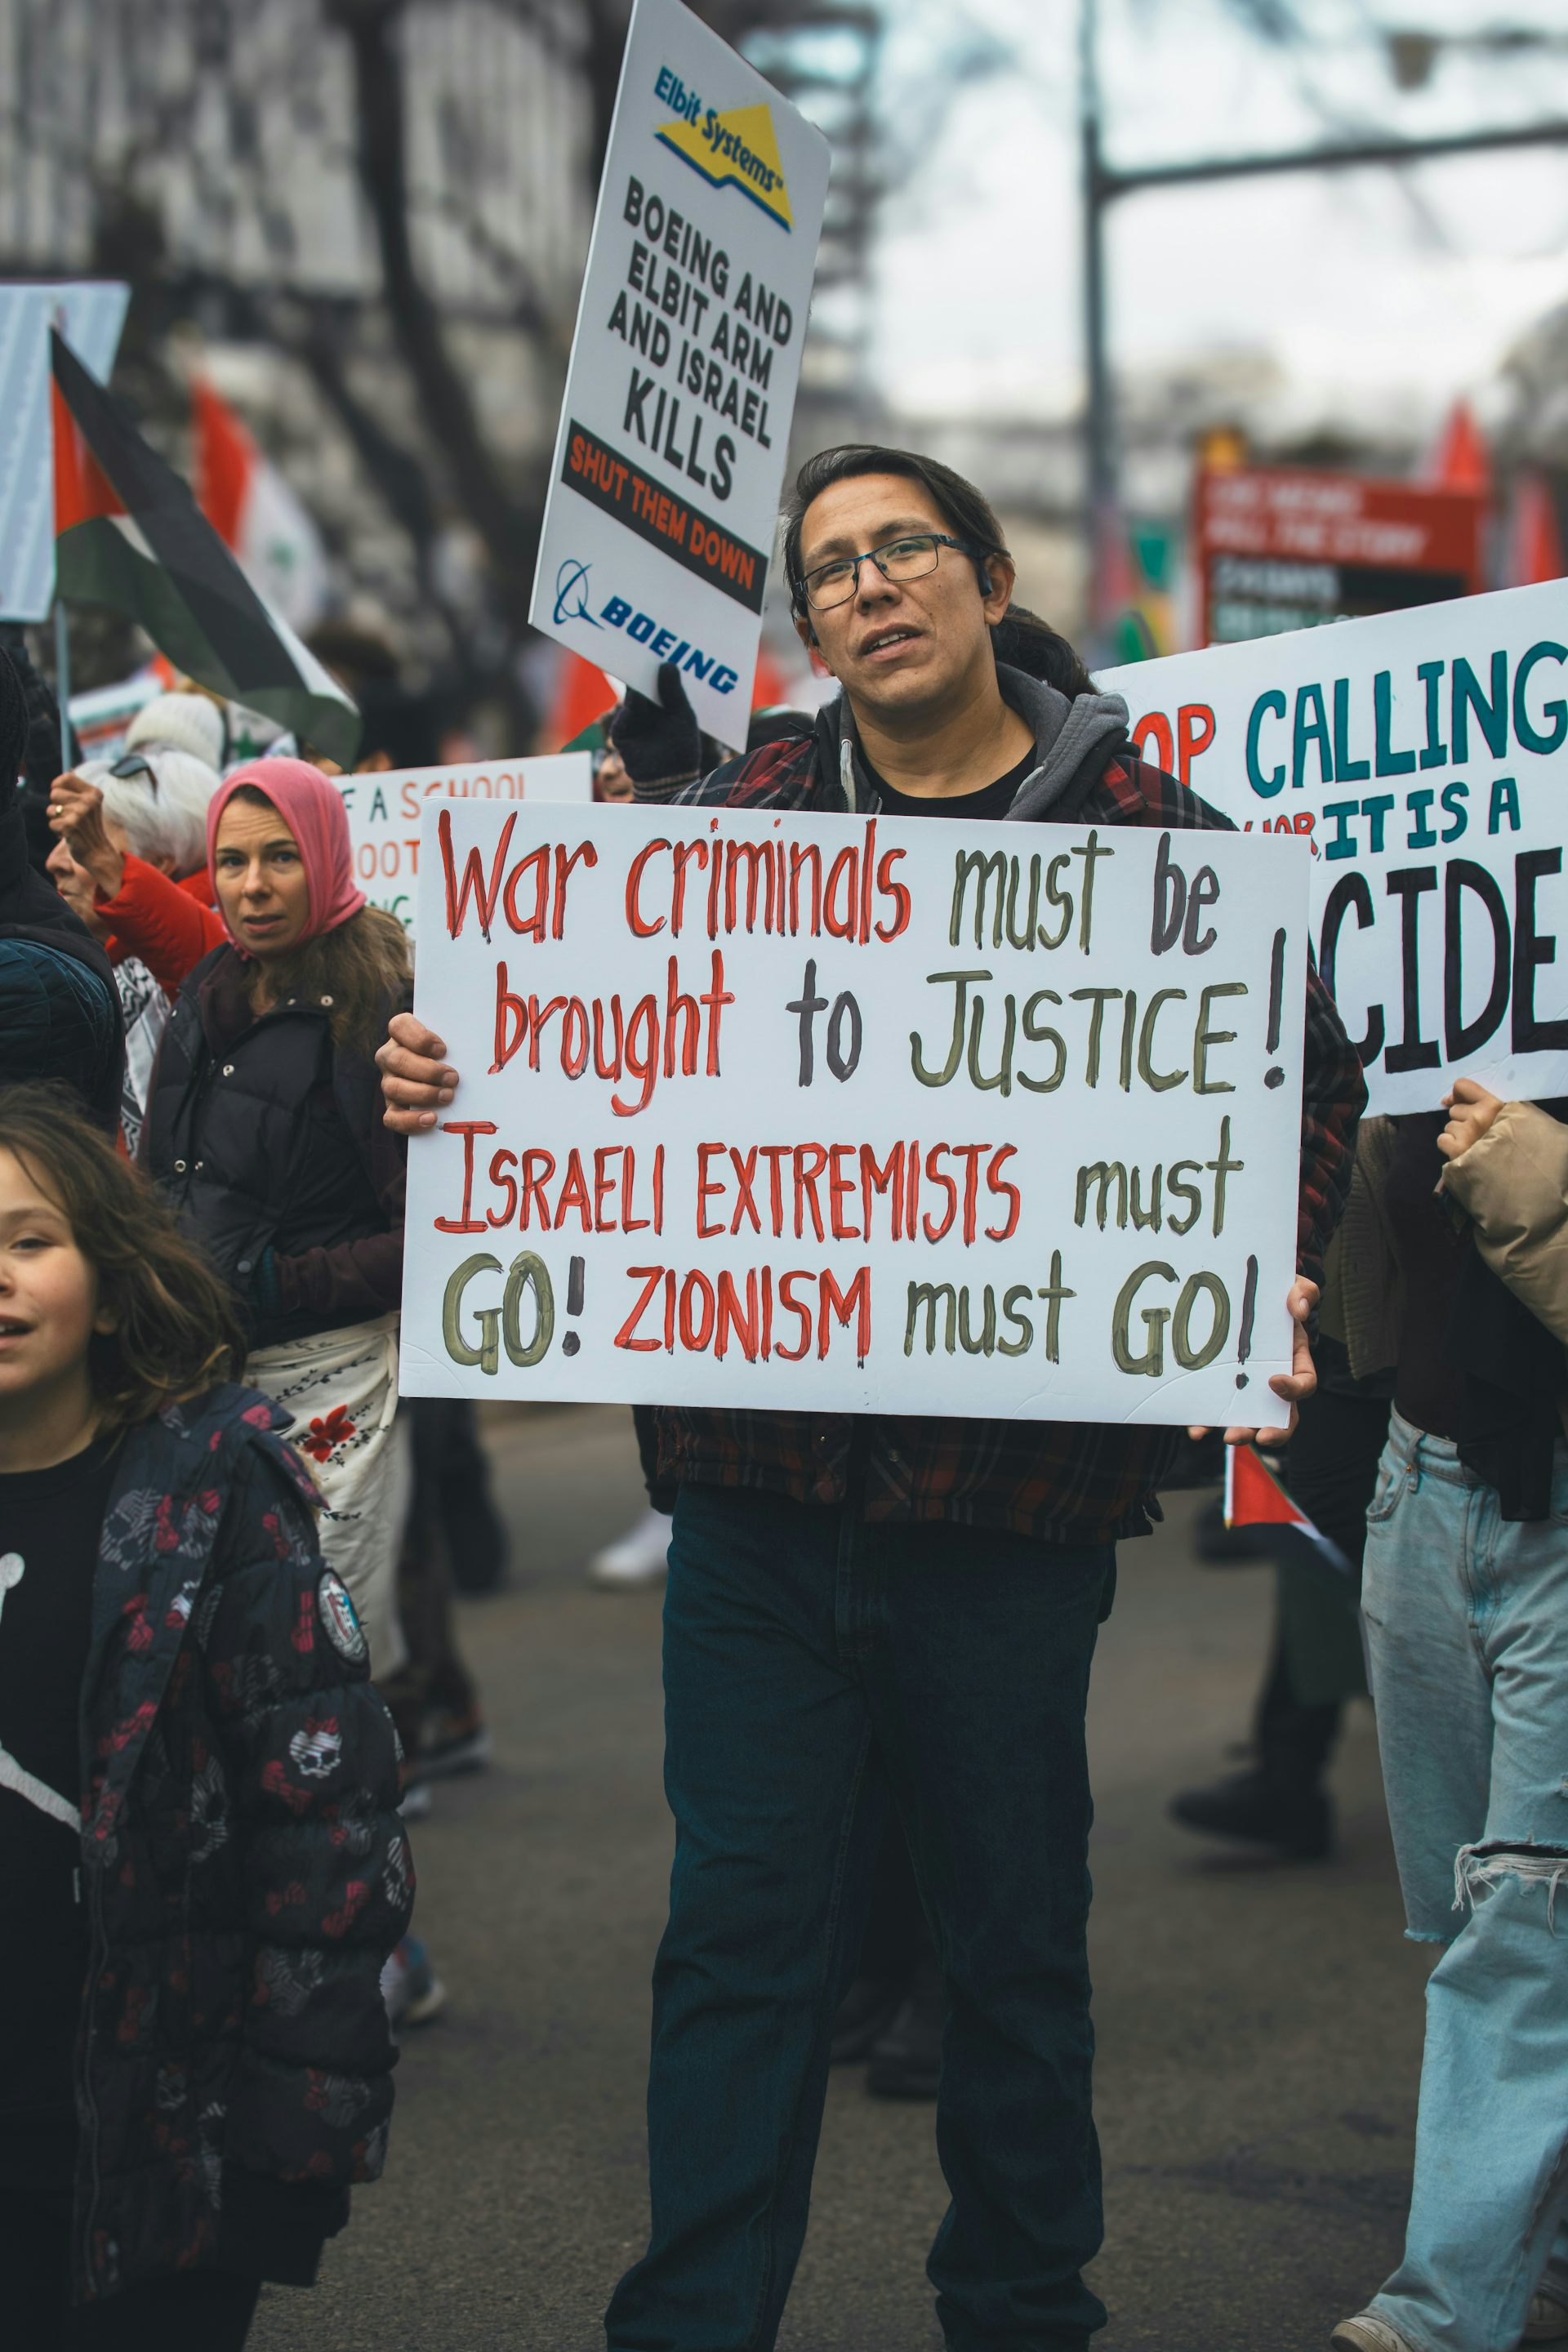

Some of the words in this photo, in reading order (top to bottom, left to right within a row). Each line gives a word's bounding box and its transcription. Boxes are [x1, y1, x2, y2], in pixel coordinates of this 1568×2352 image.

[653, 65, 702, 127] Elbit
[623, 174, 731, 300] BOEING
[734, 272, 794, 346] AND
[627, 240, 709, 336] ELBIT
[710, 312, 774, 390] ARM
[608, 290, 672, 368] AND
[677, 339, 772, 449] ISRAEL
[623, 367, 736, 501] KILLS
[569, 434, 630, 504] SHUT
[631, 477, 689, 546] THEM
[689, 521, 755, 591] DOWN
[599, 595, 739, 696] BOEING
[1131, 703, 1216, 787] OP
[1245, 640, 1568, 799] CALLING
[369, 786, 389, 823] A
[1323, 794, 1394, 861] IT
[1406, 782, 1469, 849] IS
[1488, 777, 1521, 835] A
[438, 808, 599, 944] War
[626, 817, 911, 947] criminals
[949, 829, 1115, 956] must
[1151, 831, 1221, 956] be
[488, 949, 735, 1117] brought
[786, 958, 862, 1088] to
[1308, 847, 1568, 1074] CIDE
[434, 1120, 666, 1237] ISRAELI
[696, 1139, 1021, 1248] EXTREMISTS
[1074, 1114, 1245, 1240] must
[442, 1250, 586, 1376] GO!
[614, 1264, 871, 1370] ZIONISM
[903, 1249, 1077, 1365] must
[1111, 1254, 1259, 1390] GO!
